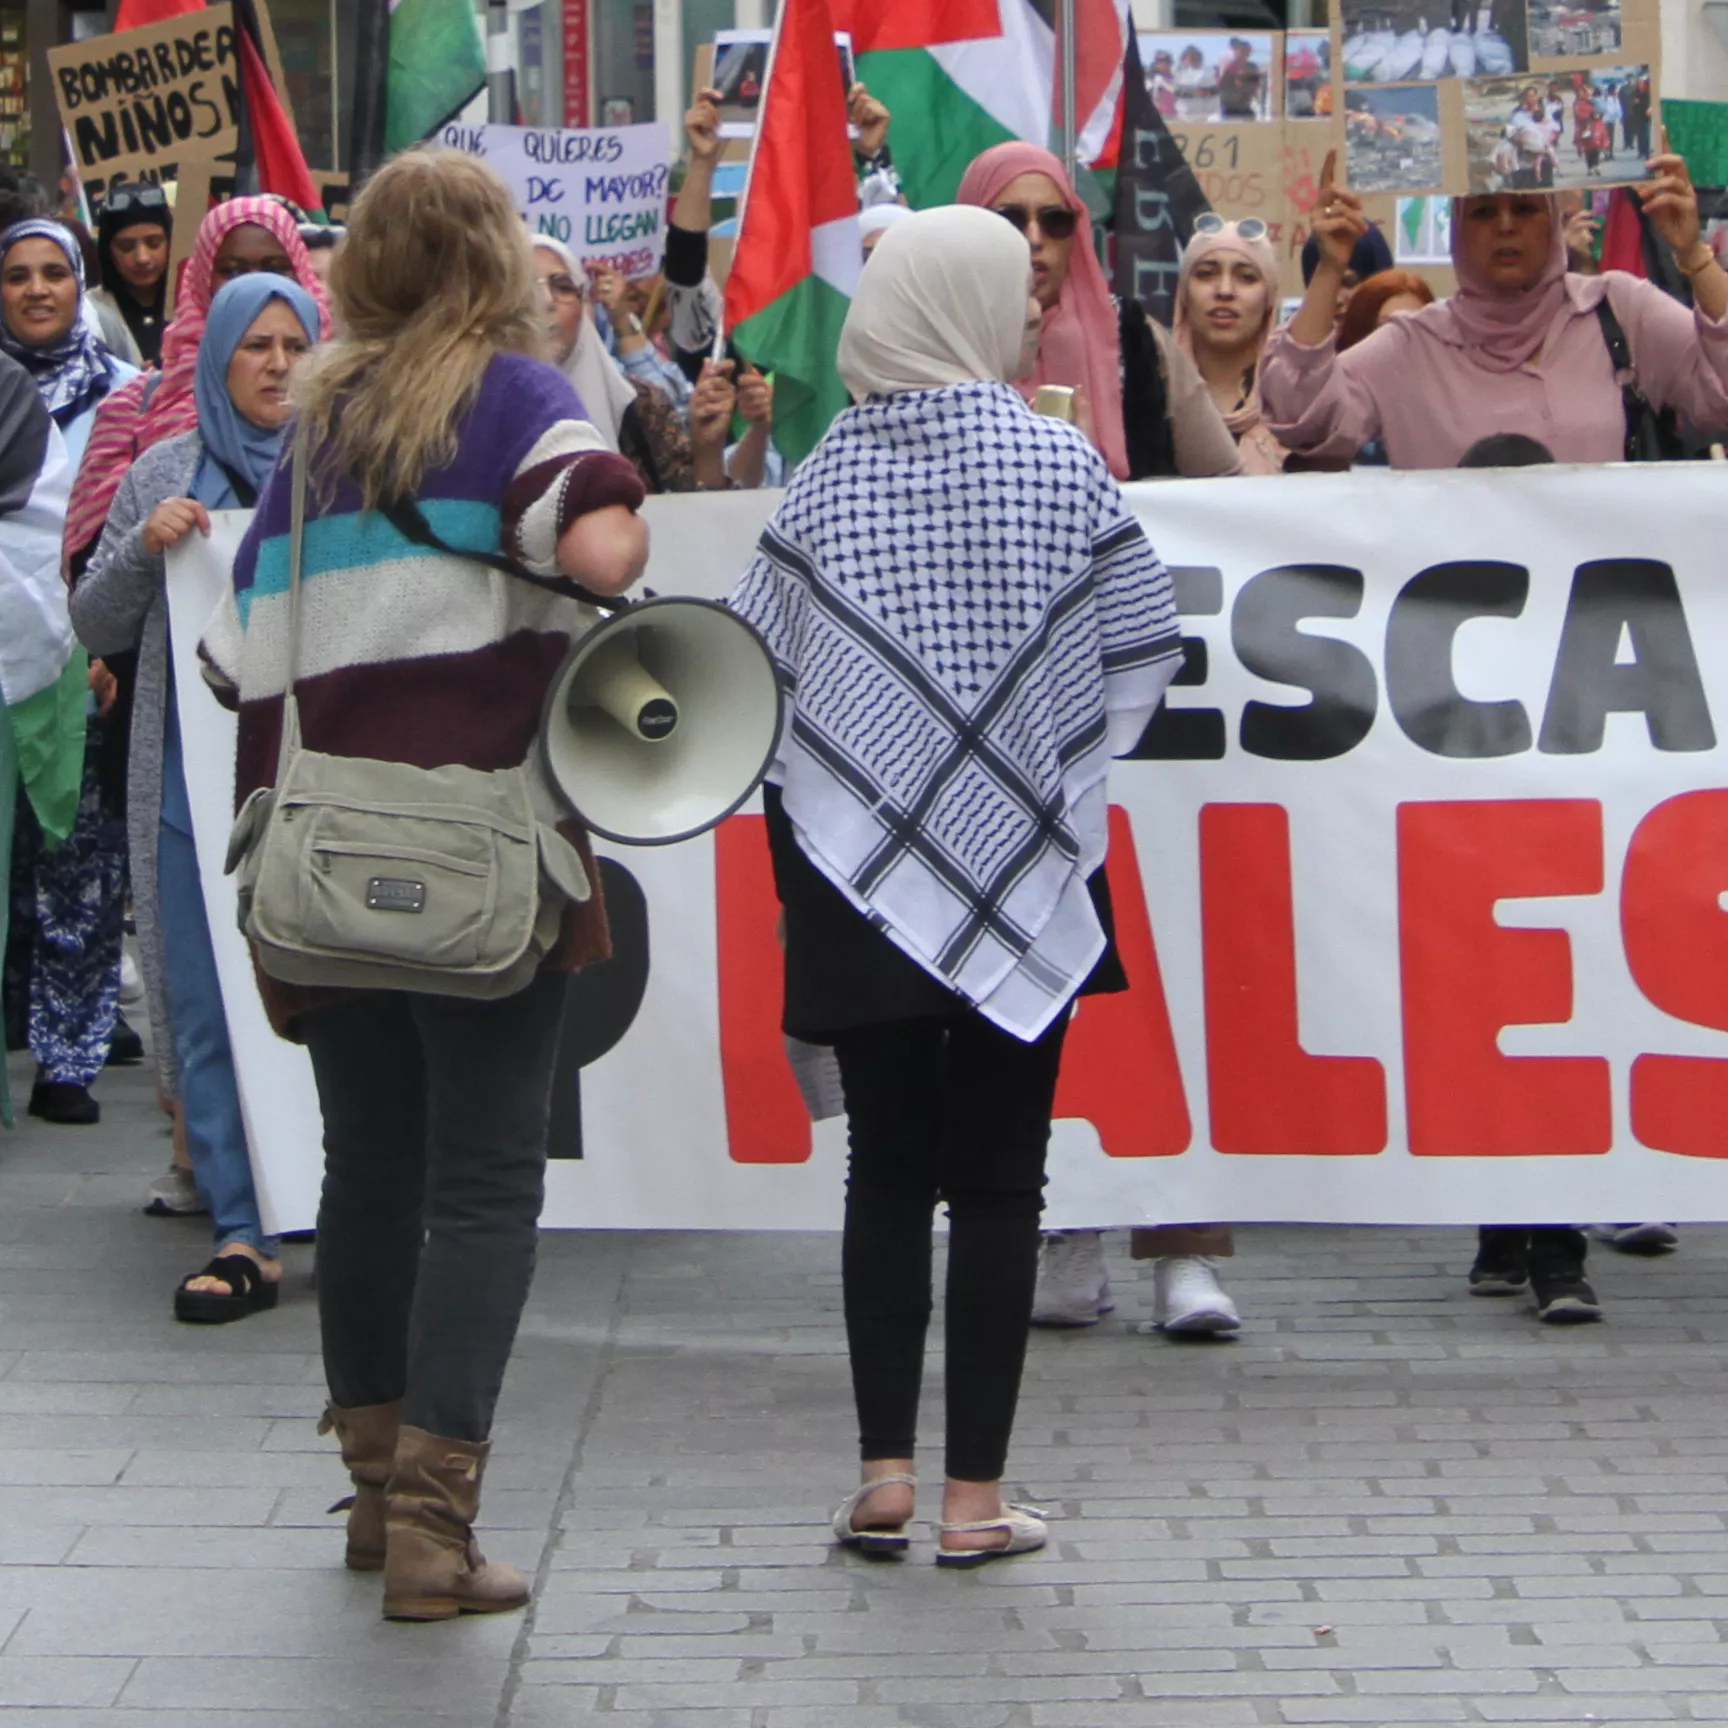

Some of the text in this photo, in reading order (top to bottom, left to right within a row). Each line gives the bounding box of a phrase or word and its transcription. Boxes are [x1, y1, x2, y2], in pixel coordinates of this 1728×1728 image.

[74, 81, 222, 167] NIÑOS
[523, 130, 623, 164] QUIERES
[527, 164, 668, 204] DE MAYOR?
[538, 208, 659, 245] NO LLEGAN
[1109, 556, 1718, 762] ESCA
